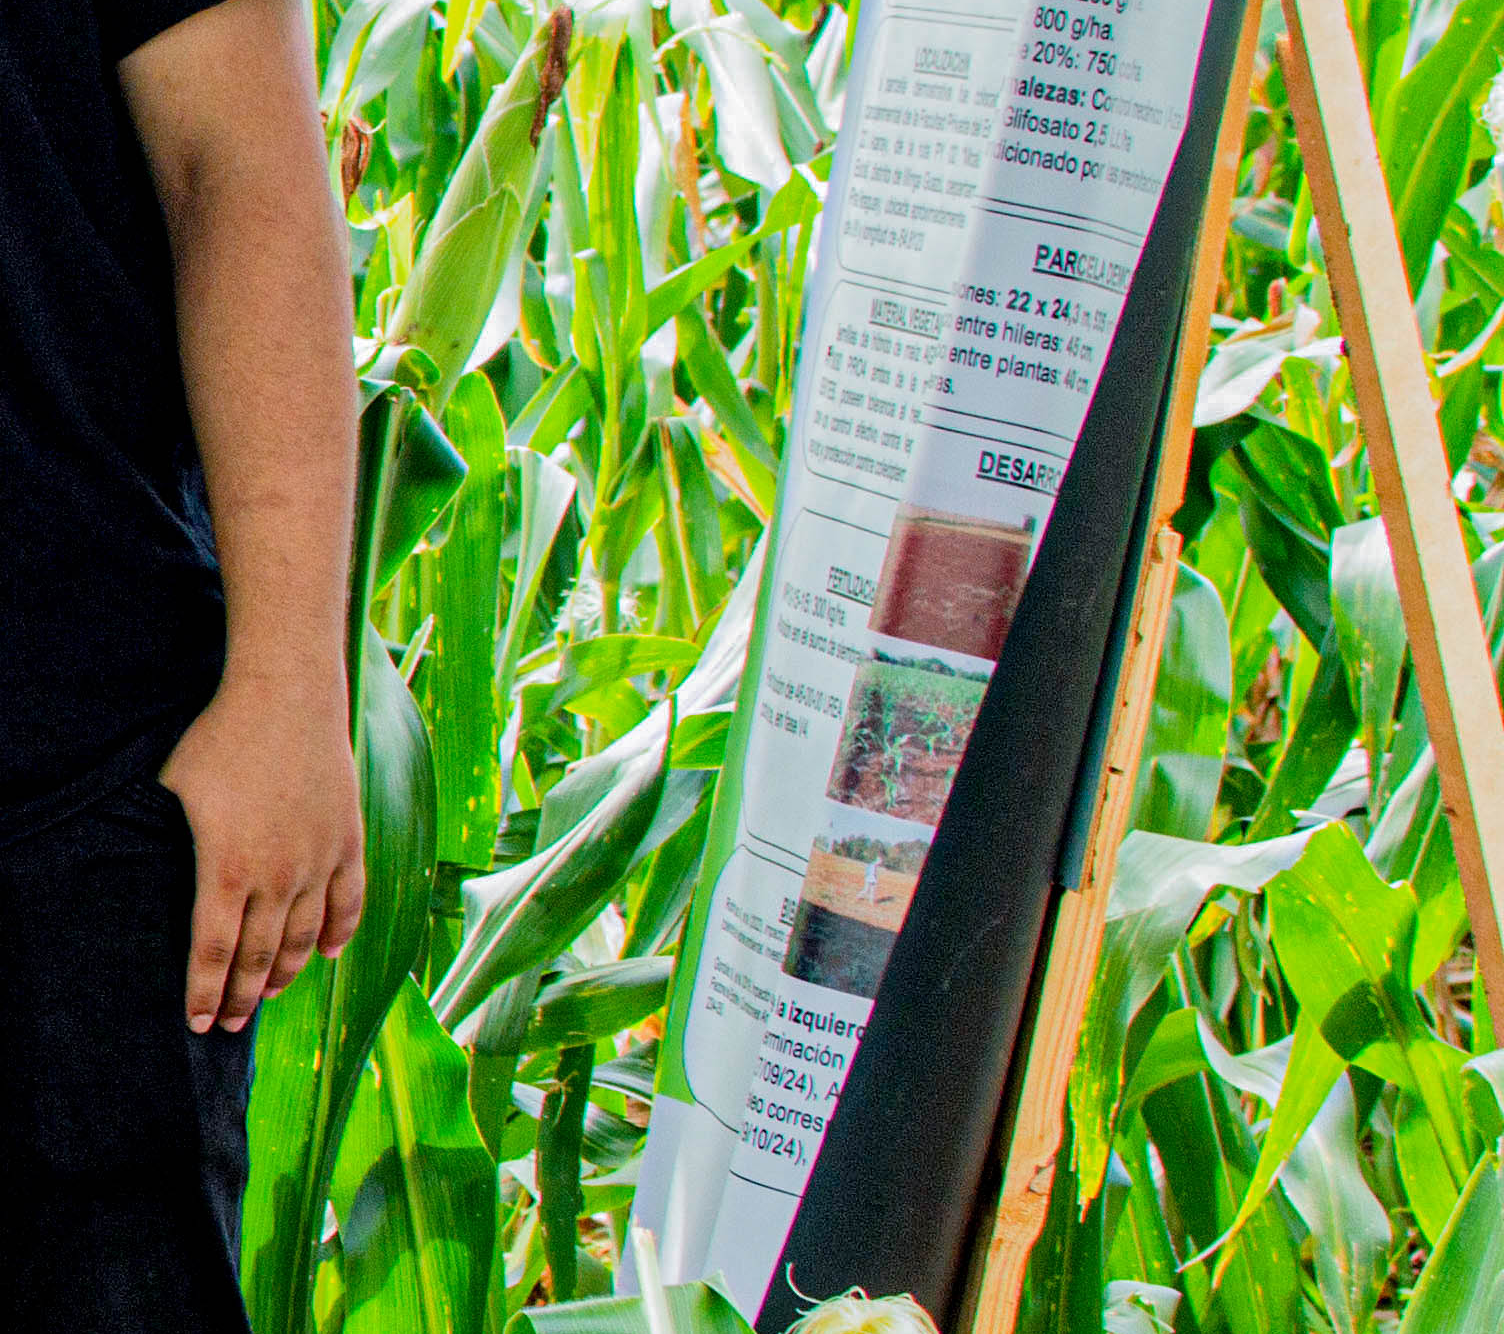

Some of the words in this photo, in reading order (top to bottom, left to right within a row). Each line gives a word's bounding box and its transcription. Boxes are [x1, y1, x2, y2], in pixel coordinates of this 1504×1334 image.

[1033, 7, 1068, 32] 800
[1070, 15, 1114, 41] g/ha.
[1032, 40, 1080, 70] 20%:
[1087, 50, 1117, 76] 750
[994, 139, 1078, 174] dicionado
[1006, 288, 1032, 313] 22
[1035, 299, 1048, 317] x
[955, 315, 998, 339] entre
[1002, 320, 1064, 353] hileras:
[949, 346, 992, 370] entre
[996, 355, 1062, 385] plantas:
[824, 1081, 840, 1101] A
[767, 1101, 825, 1133] corres
